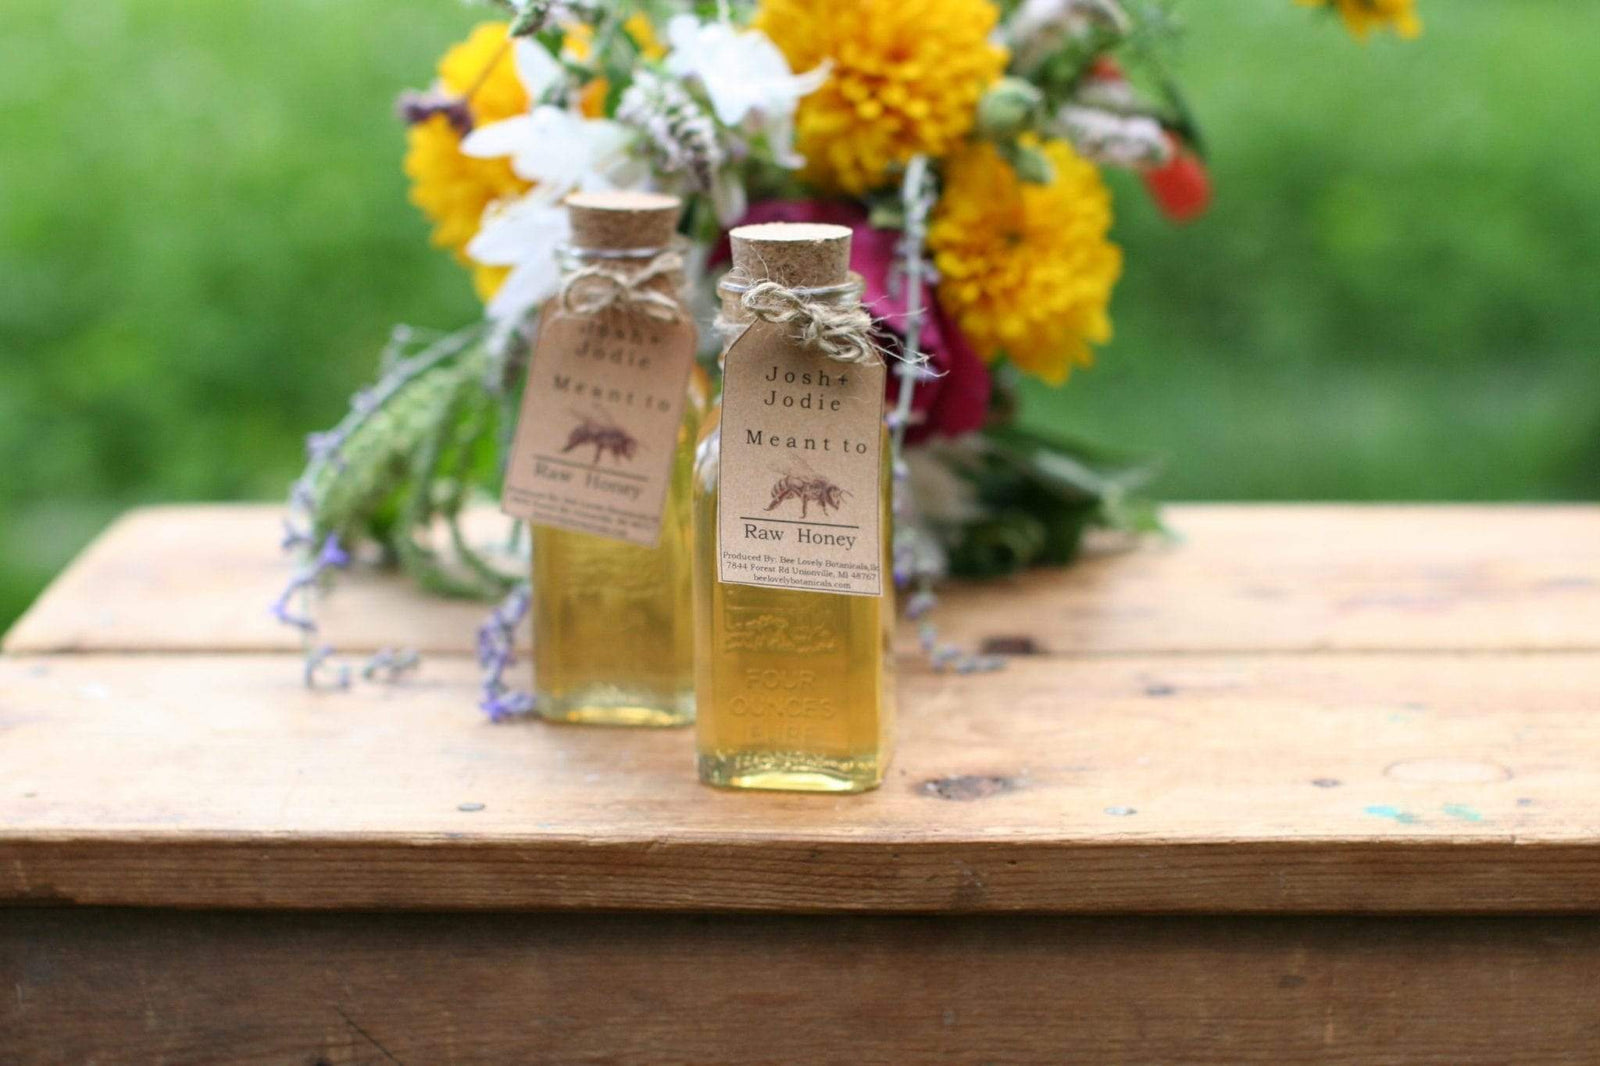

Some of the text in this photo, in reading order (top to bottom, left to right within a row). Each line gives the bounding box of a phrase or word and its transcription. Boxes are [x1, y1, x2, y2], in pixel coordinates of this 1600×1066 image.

[765, 366, 849, 387] Josh+
[764, 390, 841, 411] Jodie
[746, 429, 867, 454] Meant to
[744, 523, 857, 550] Raw Honey
[723, 552, 761, 562] Produced
[780, 556, 795, 564] Bee
[798, 558, 823, 567] Lovely
[727, 562, 747, 570] 7844
[750, 563, 776, 573] Forest
[778, 566, 790, 574] Rd
[838, 570, 849, 579] MI
[851, 573, 877, 581] 48767
[745, 668, 816, 690] FOUR
